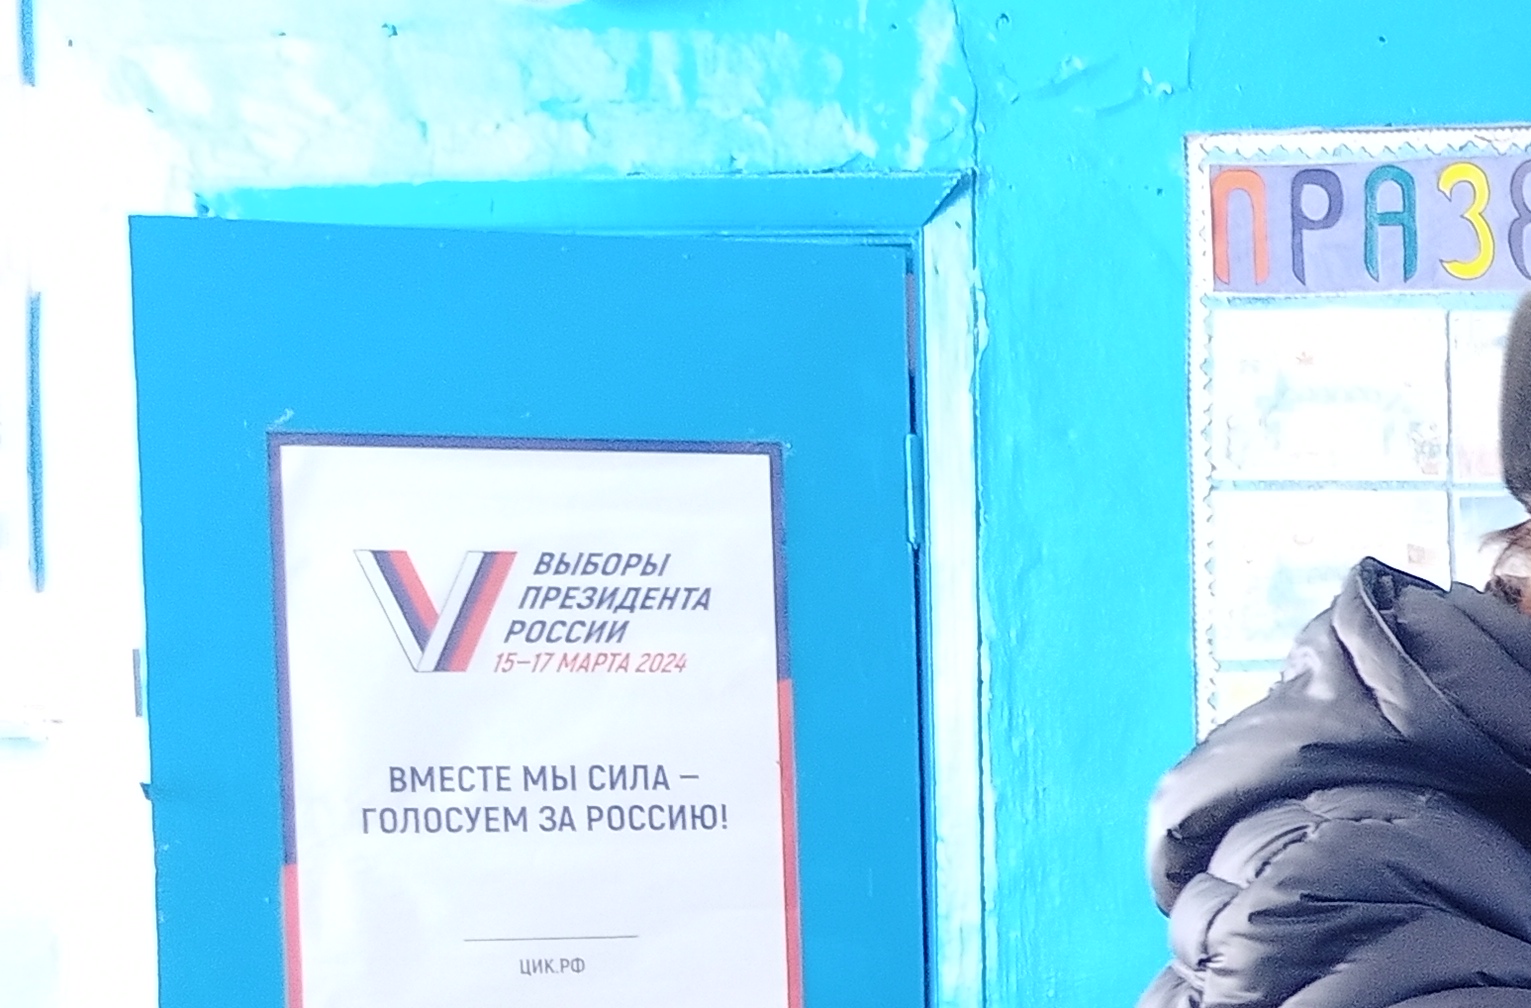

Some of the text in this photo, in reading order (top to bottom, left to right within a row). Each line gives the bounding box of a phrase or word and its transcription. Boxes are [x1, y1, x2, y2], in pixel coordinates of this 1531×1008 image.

[532, 551, 672, 577] ВЫБОРЫ
[517, 585, 712, 614] ПРЕЗИДЕНТА
[503, 619, 631, 645] РОССИИ
[560, 652, 631, 673] МАРТА
[635, 652, 688, 674] 2024
[388, 765, 512, 794] ВМЕСТЕ
[522, 764, 577, 792] МЫ
[588, 764, 671, 792] СИЛА
[361, 803, 729, 835] ГОЛОСУЕМ ЗА РОССИЮ!
[519, 957, 586, 977] ЦИК.РФ
